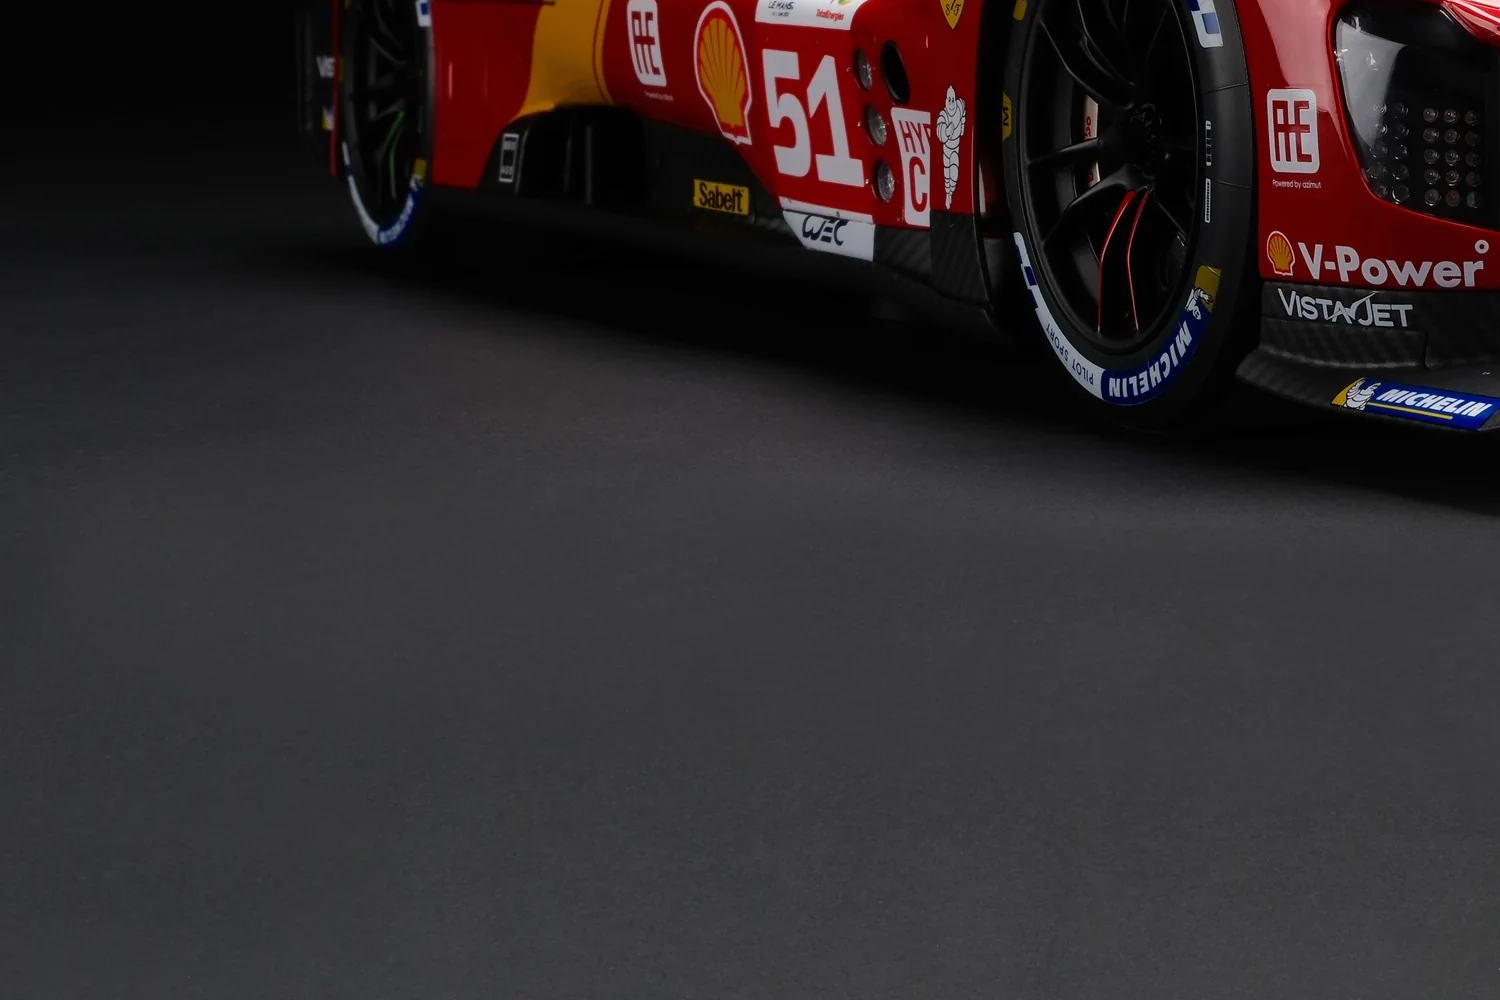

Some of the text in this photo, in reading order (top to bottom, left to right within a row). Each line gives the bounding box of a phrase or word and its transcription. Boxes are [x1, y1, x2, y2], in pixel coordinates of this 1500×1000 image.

[762, 48, 866, 188] 51
[699, 181, 744, 213] Sabelt
[1272, 179, 1294, 188] Powered
[1294, 180, 1301, 189] by
[802, 215, 849, 246] WEC
[1298, 241, 1485, 288] V-Power
[1045, 322, 1095, 386] PILOT SPORT
[1109, 320, 1193, 398] MICHELIN
[1376, 388, 1493, 417] MICHELIN
